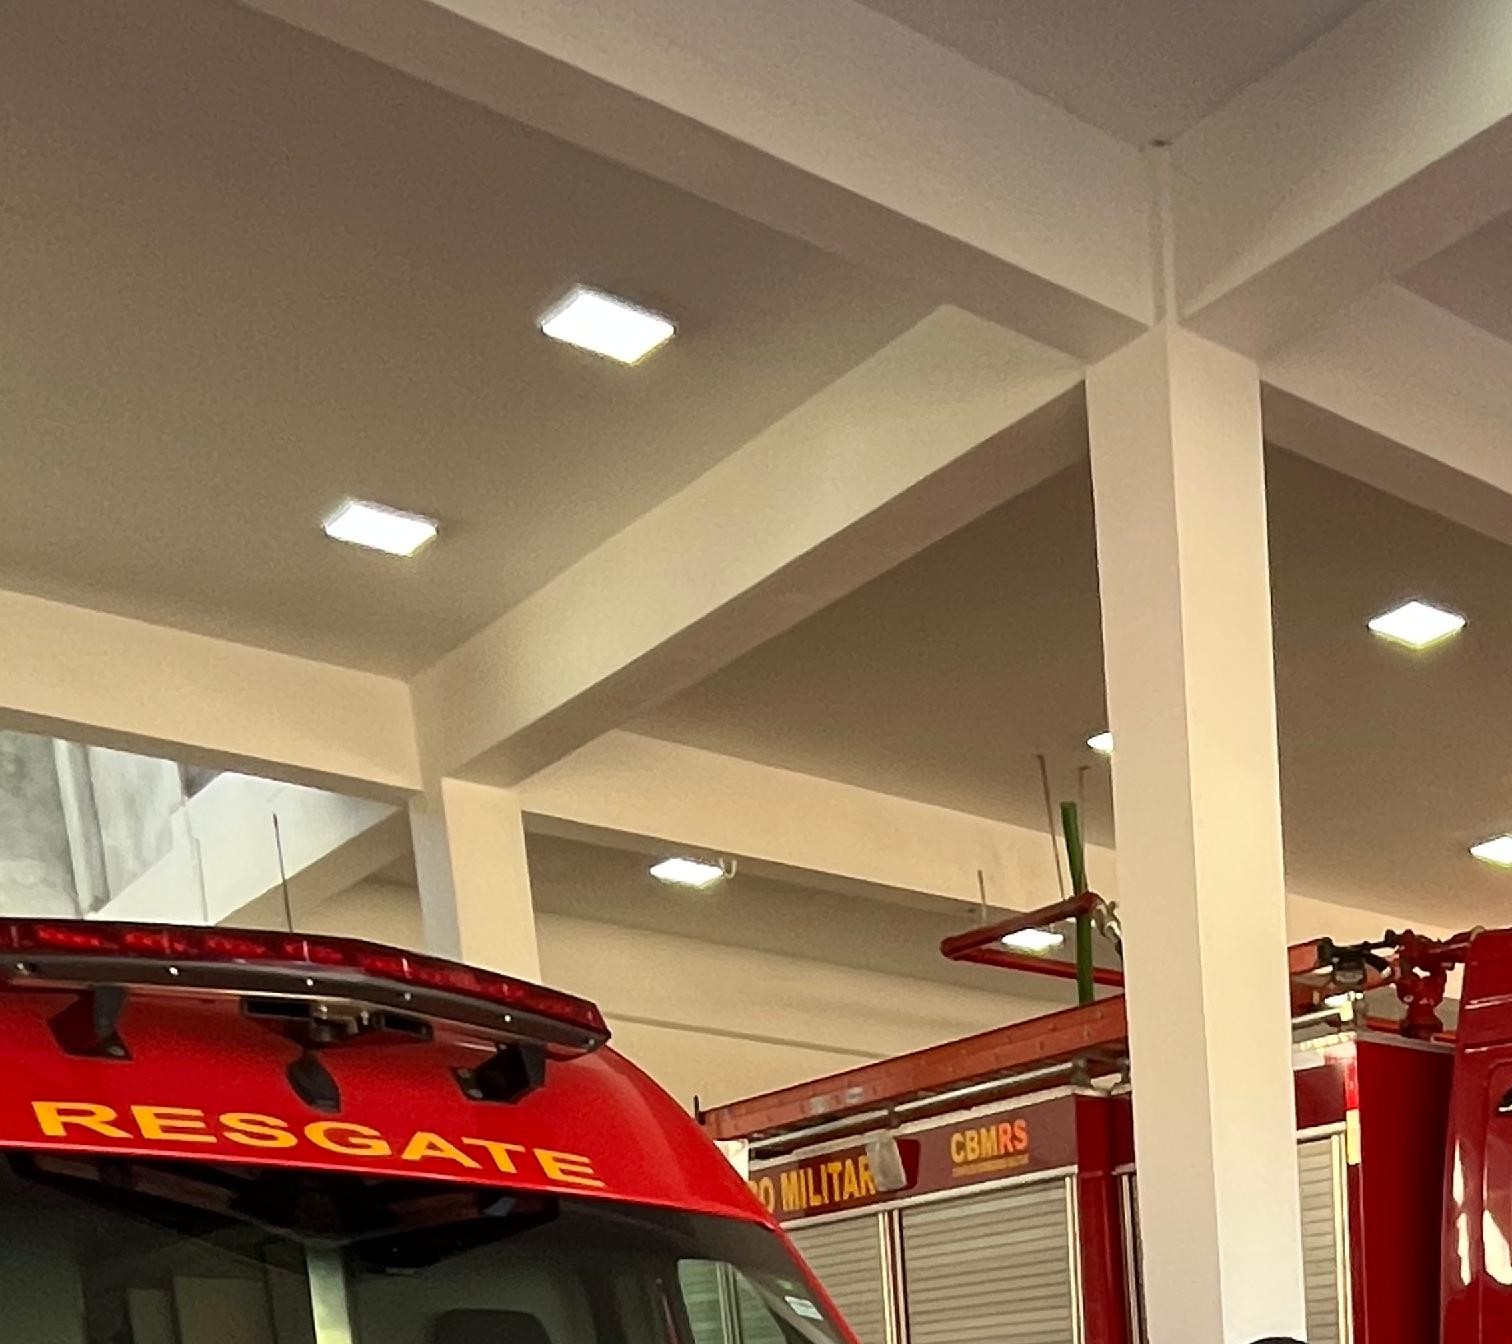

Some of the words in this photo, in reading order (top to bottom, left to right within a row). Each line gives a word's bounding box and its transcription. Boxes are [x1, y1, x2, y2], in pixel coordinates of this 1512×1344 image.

[32, 1101, 606, 1188] RESGATE
[951, 1119, 1029, 1164] CBMRS
[780, 1155, 876, 1212] MILITAR
